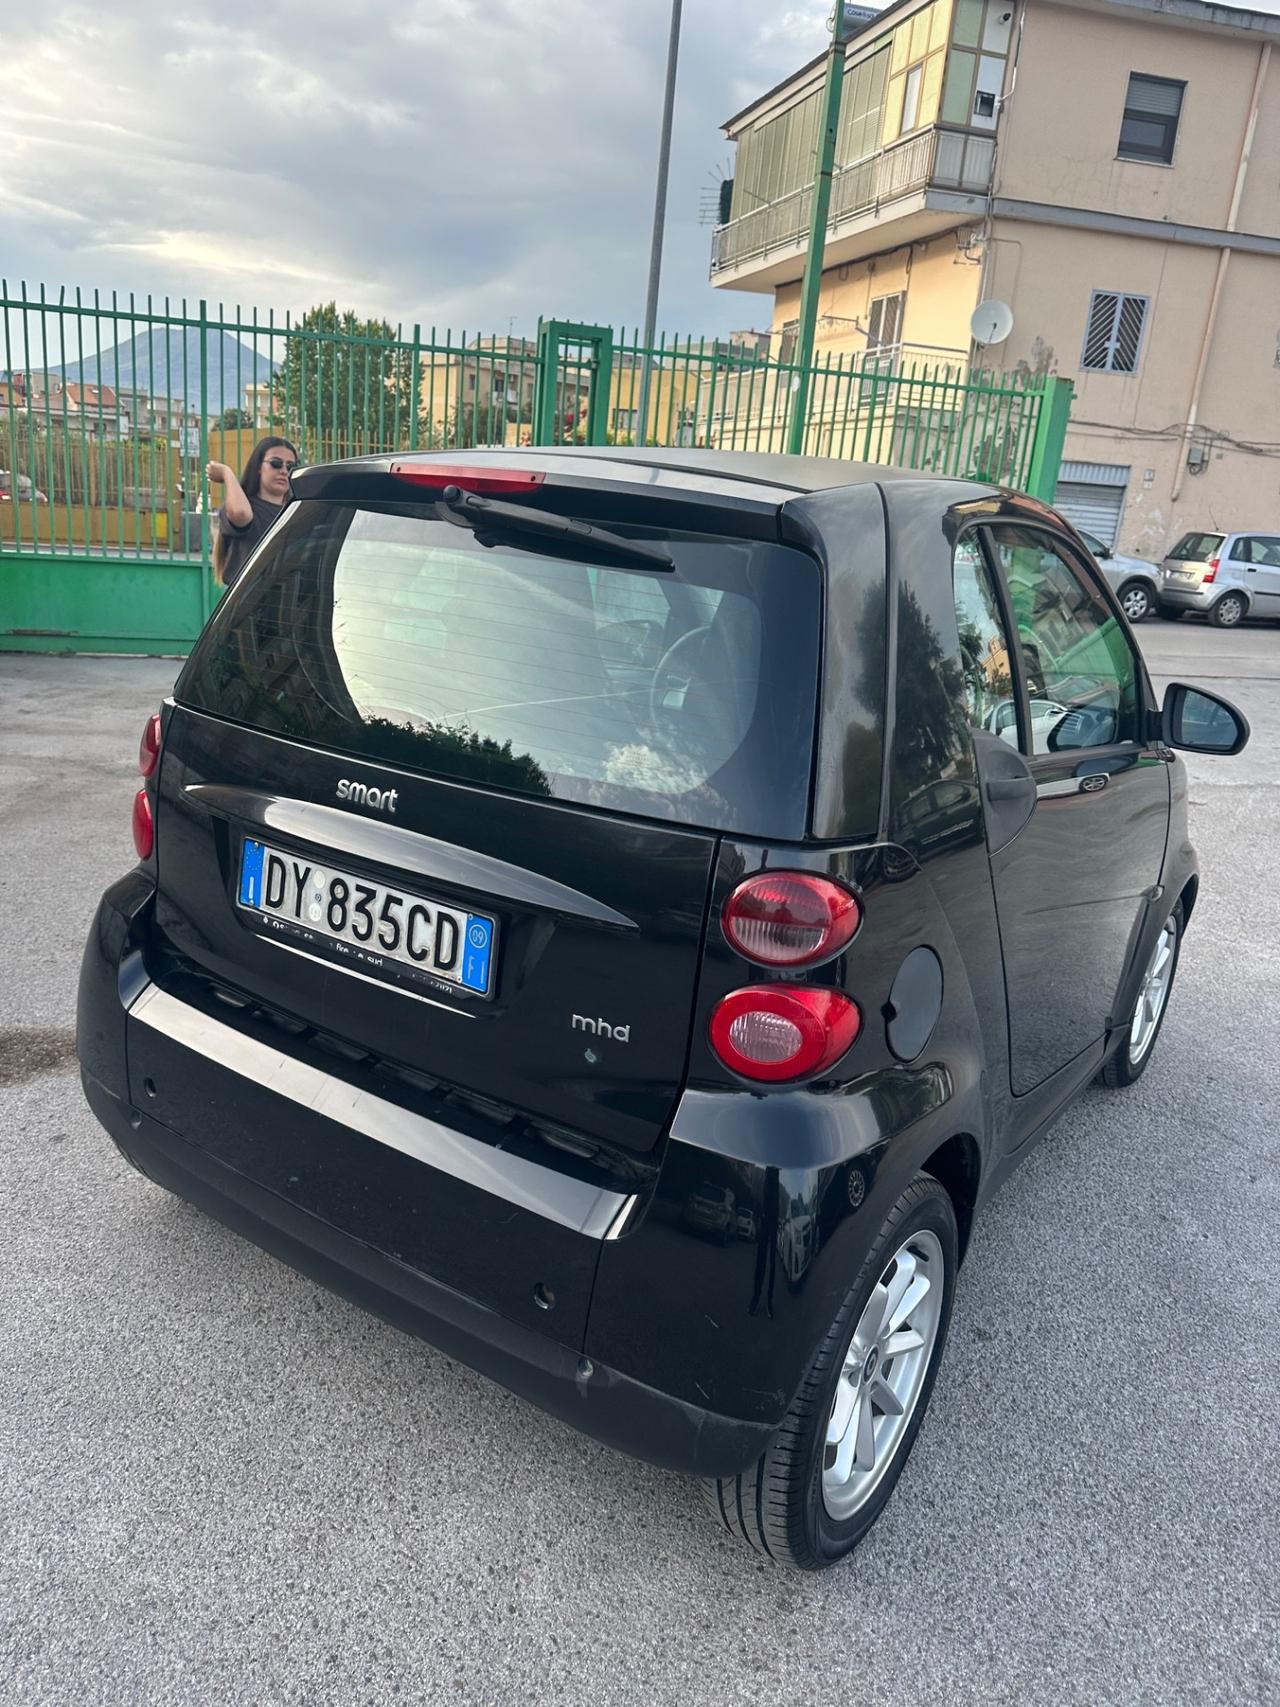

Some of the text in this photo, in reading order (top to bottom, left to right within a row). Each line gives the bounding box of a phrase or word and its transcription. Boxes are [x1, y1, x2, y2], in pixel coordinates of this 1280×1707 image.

[336, 779, 398, 812] smart
[473, 929, 484, 944] 09
[572, 1014, 630, 1043] mhd
